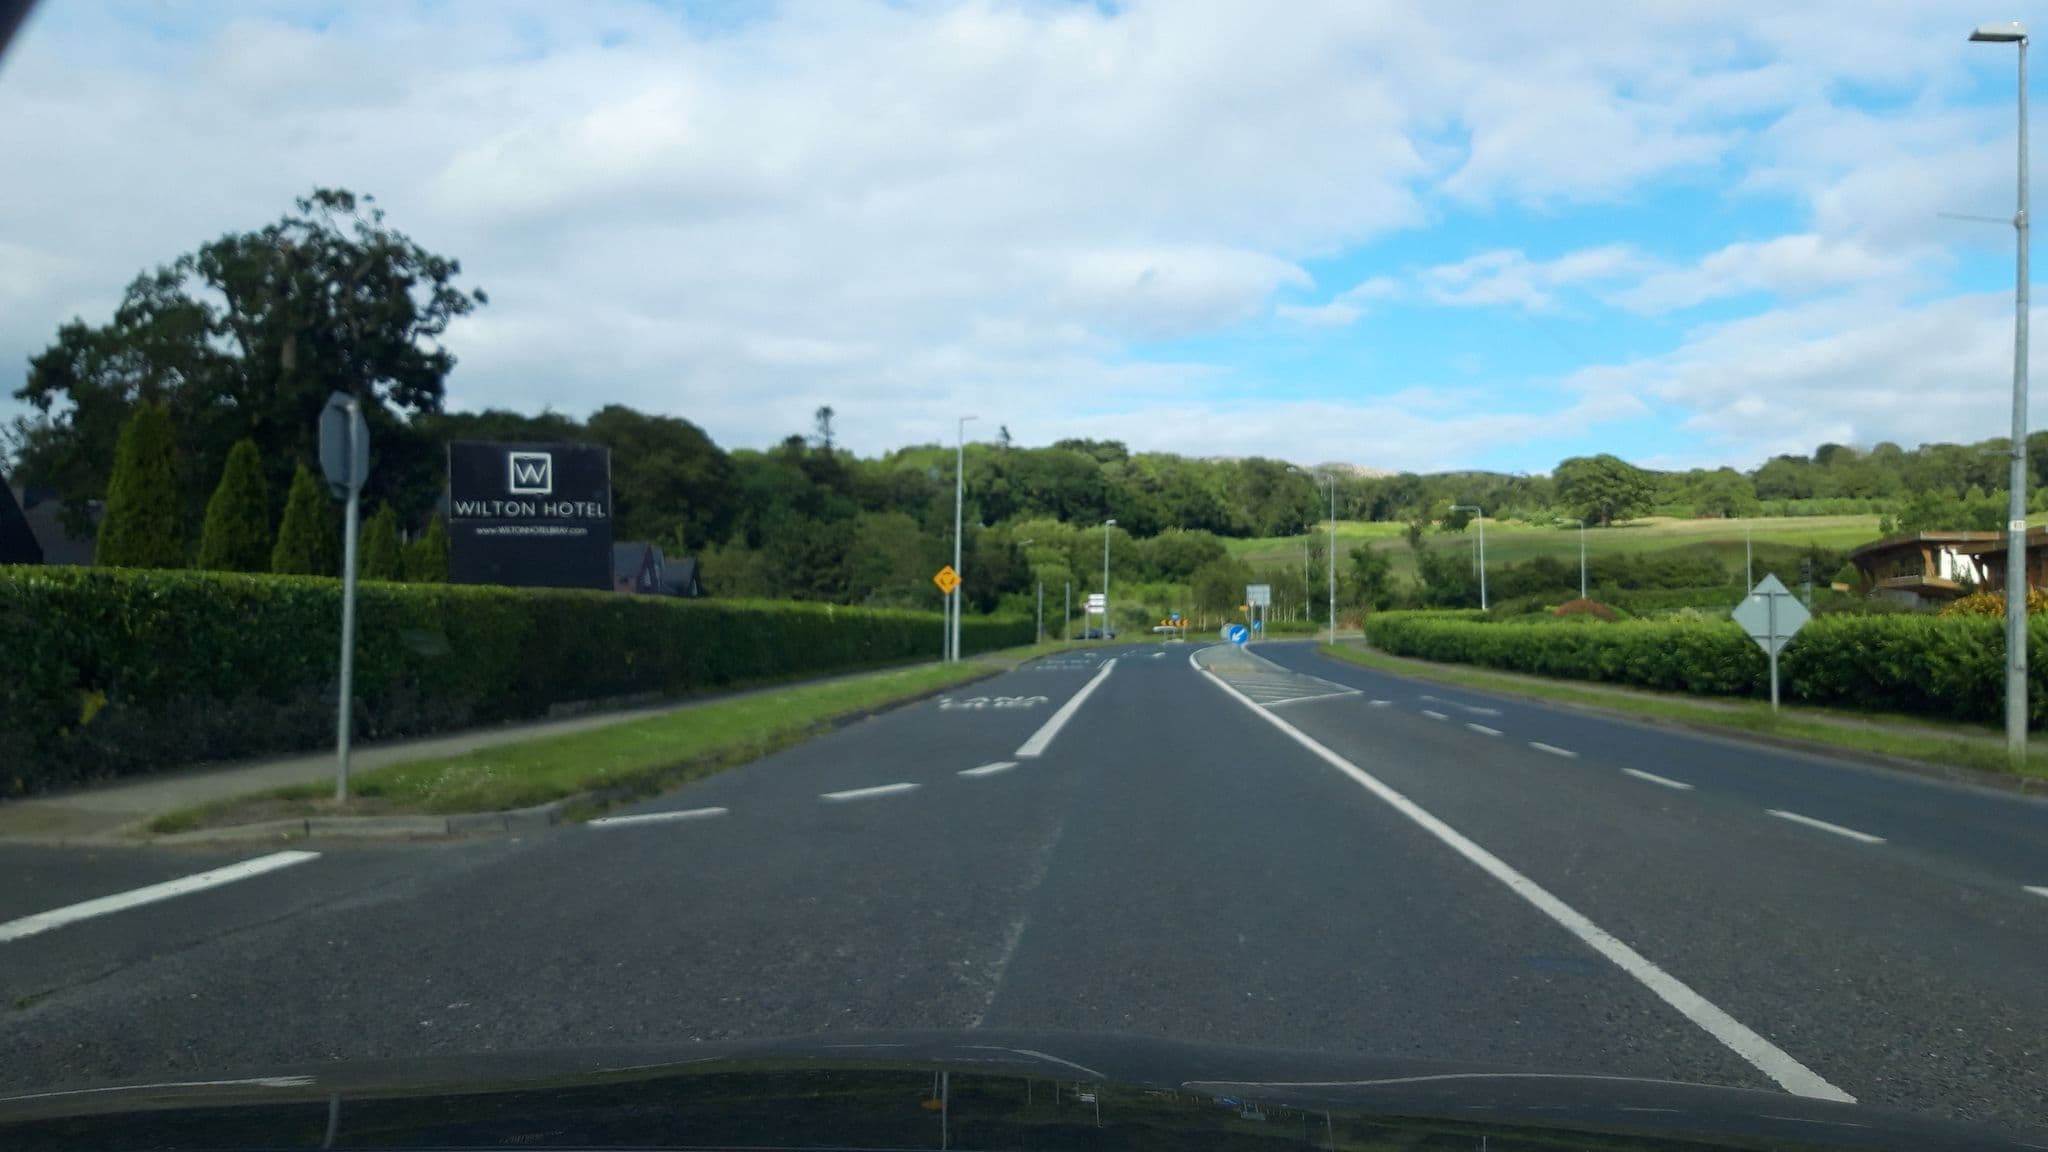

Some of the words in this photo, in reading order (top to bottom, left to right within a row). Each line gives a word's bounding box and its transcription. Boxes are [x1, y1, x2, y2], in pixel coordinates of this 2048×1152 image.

[515, 463, 547, 484] W
[455, 500, 536, 517] WILTON
[544, 501, 606, 517] HOTEL
